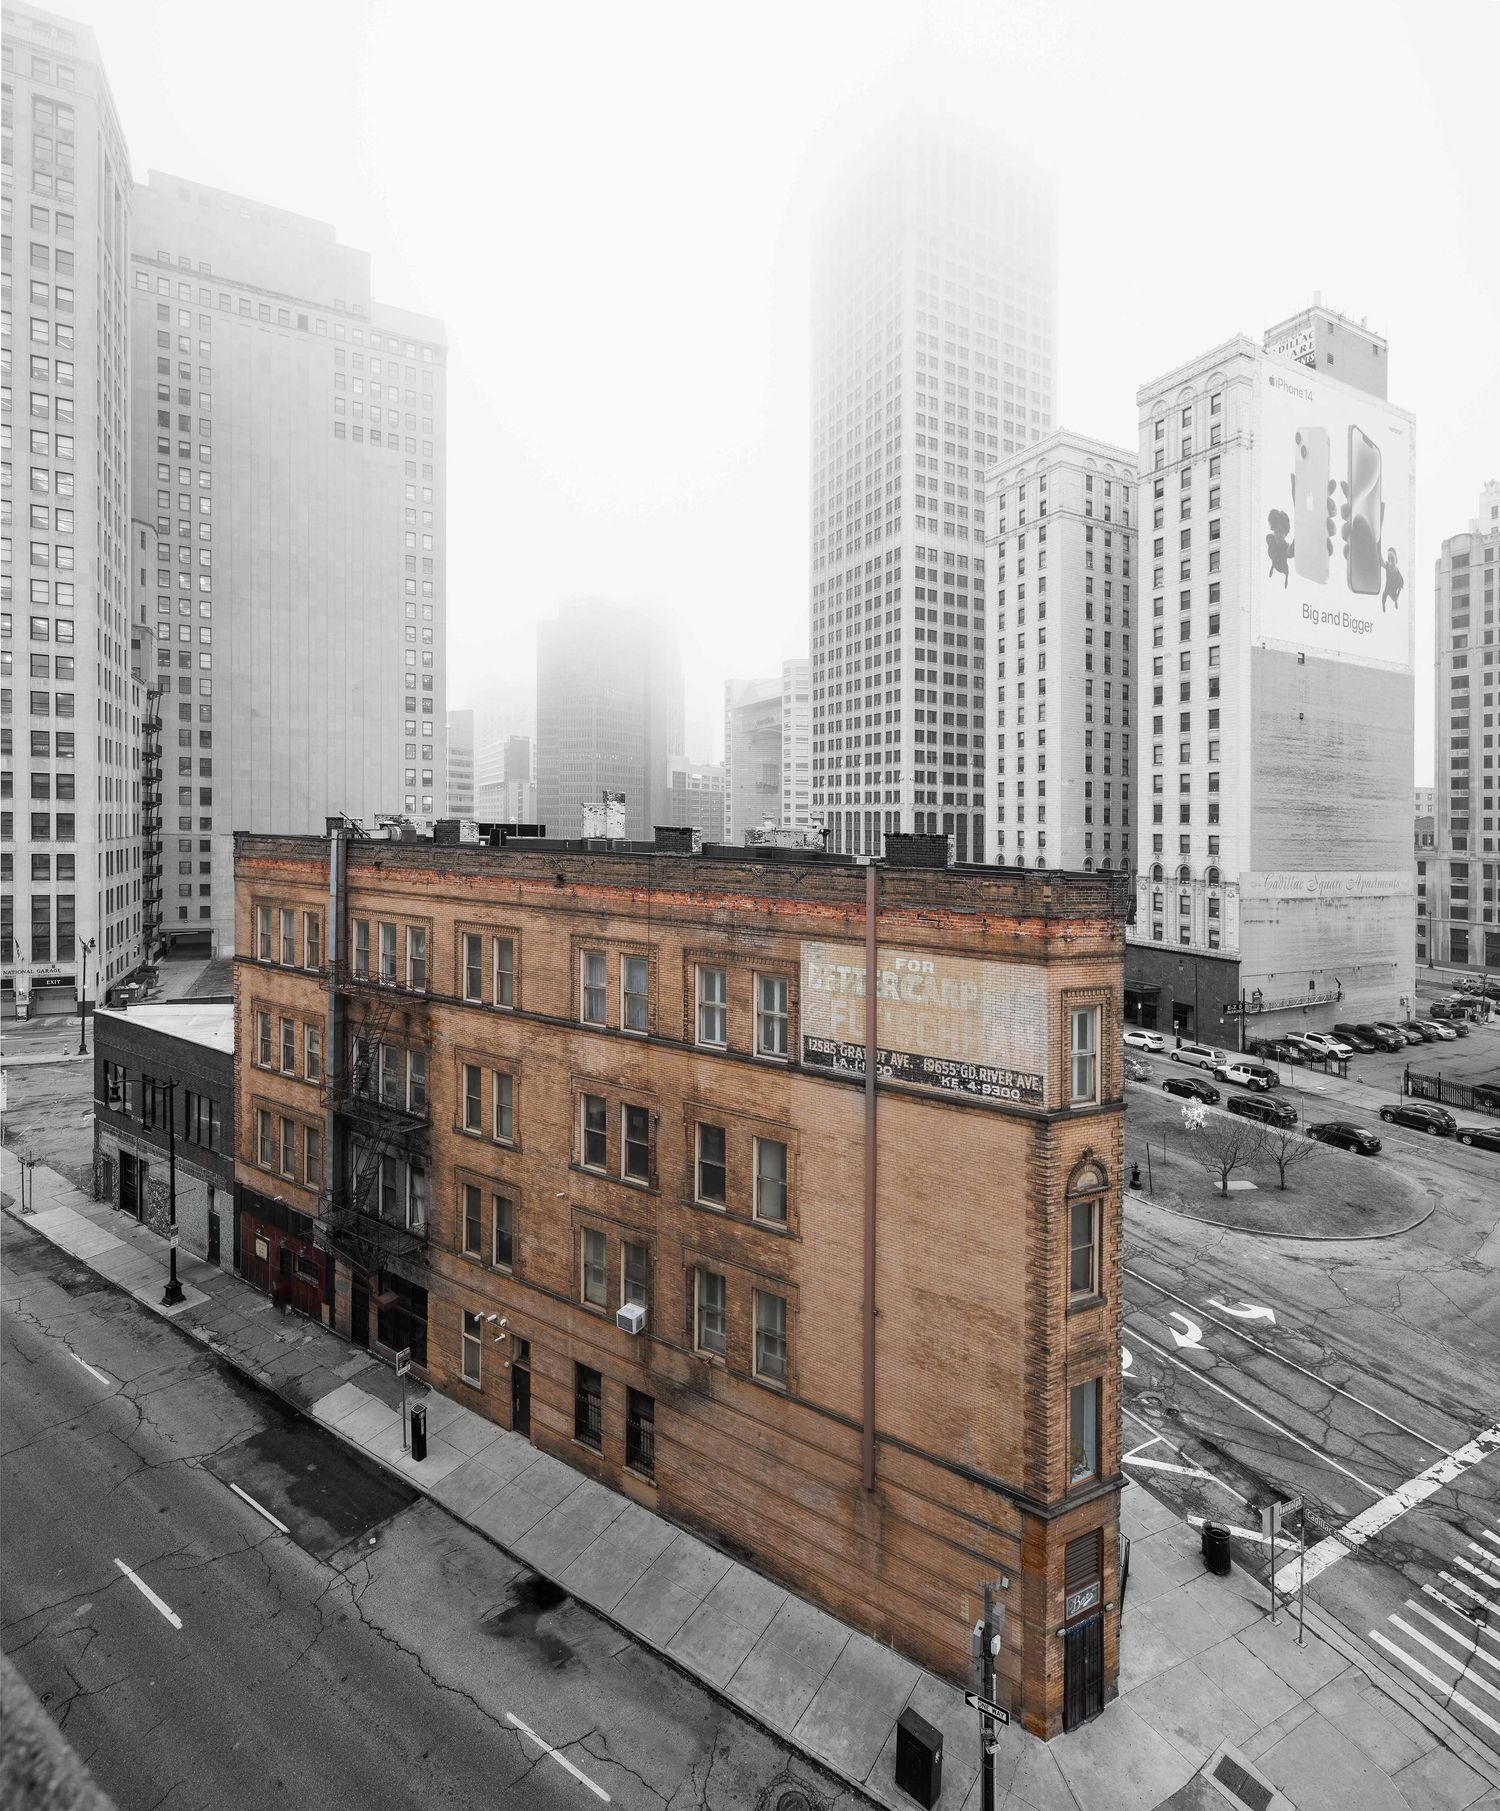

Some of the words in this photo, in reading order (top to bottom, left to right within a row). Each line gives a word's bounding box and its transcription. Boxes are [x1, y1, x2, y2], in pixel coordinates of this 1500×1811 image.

[1275, 376, 1303, 399] iPhone
[1304, 389, 1313, 402] 14
[1302, 603, 1319, 625] Big
[1321, 611, 1340, 626] and
[1342, 612, 1374, 634] Bigger
[1263, 872, 1304, 890] Cadillac
[895, 957, 935, 974] FOR
[809, 1038, 837, 1055] 12585
[890, 1052, 914, 1069] AVE.
[923, 1058, 956, 1076] 19655
[1016, 1074, 1043, 1091] AVE.
[941, 1076, 964, 1089] KE.
[1307, 1511, 1333, 1534] Cadillac
[1333, 1530, 1358, 1552] Square
[977, 1701, 990, 1712] ONE
[991, 1708, 1005, 1719] WAY
